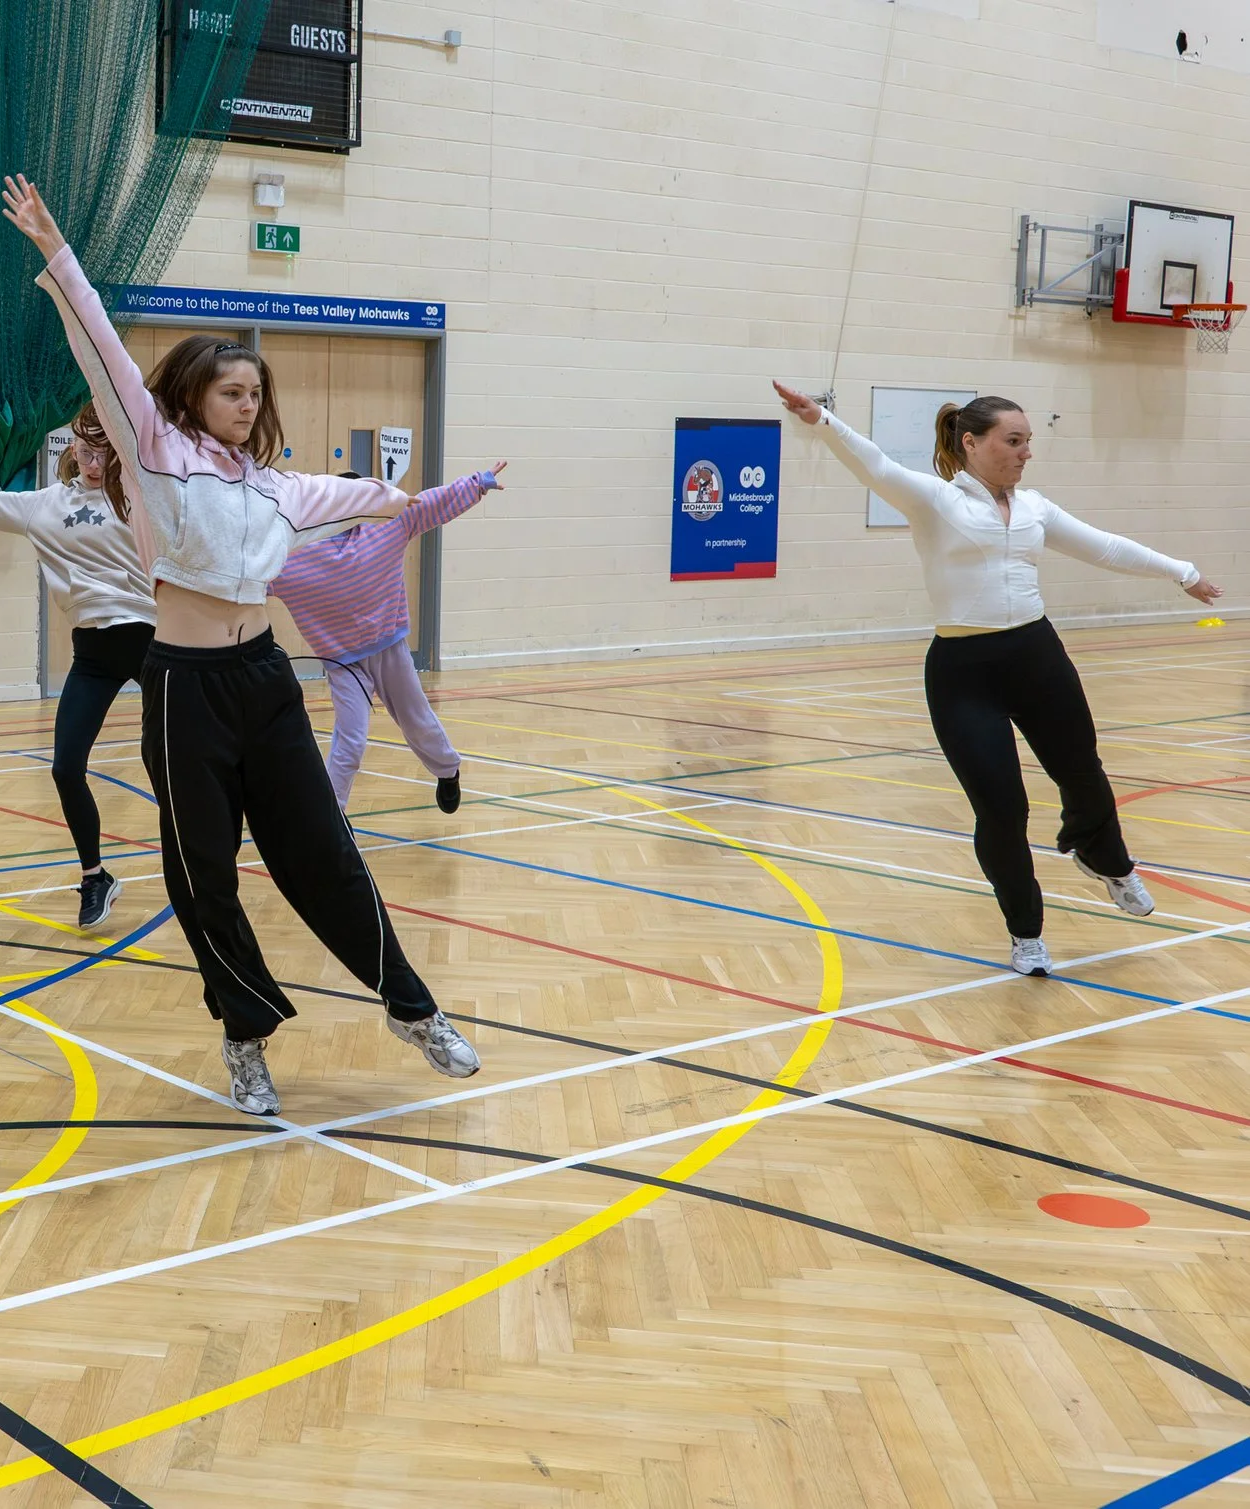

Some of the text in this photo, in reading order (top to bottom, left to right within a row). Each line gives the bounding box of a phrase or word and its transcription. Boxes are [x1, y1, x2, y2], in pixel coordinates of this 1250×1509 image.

[290, 24, 346, 53] GUESTS
[220, 99, 311, 120] CONTINENTAL
[126, 293, 410, 321] Welcome to the home of the Tees Valley Mohawks
[49, 436, 73, 445] TOILE
[381, 434, 409, 445] TOILETS
[391, 447, 409, 455] WAY
[729, 493, 775, 504] Middlesbrough
[683, 503, 722, 511] MOHAWKS
[739, 504, 764, 515] College
[705, 538, 747, 548] in partnership
